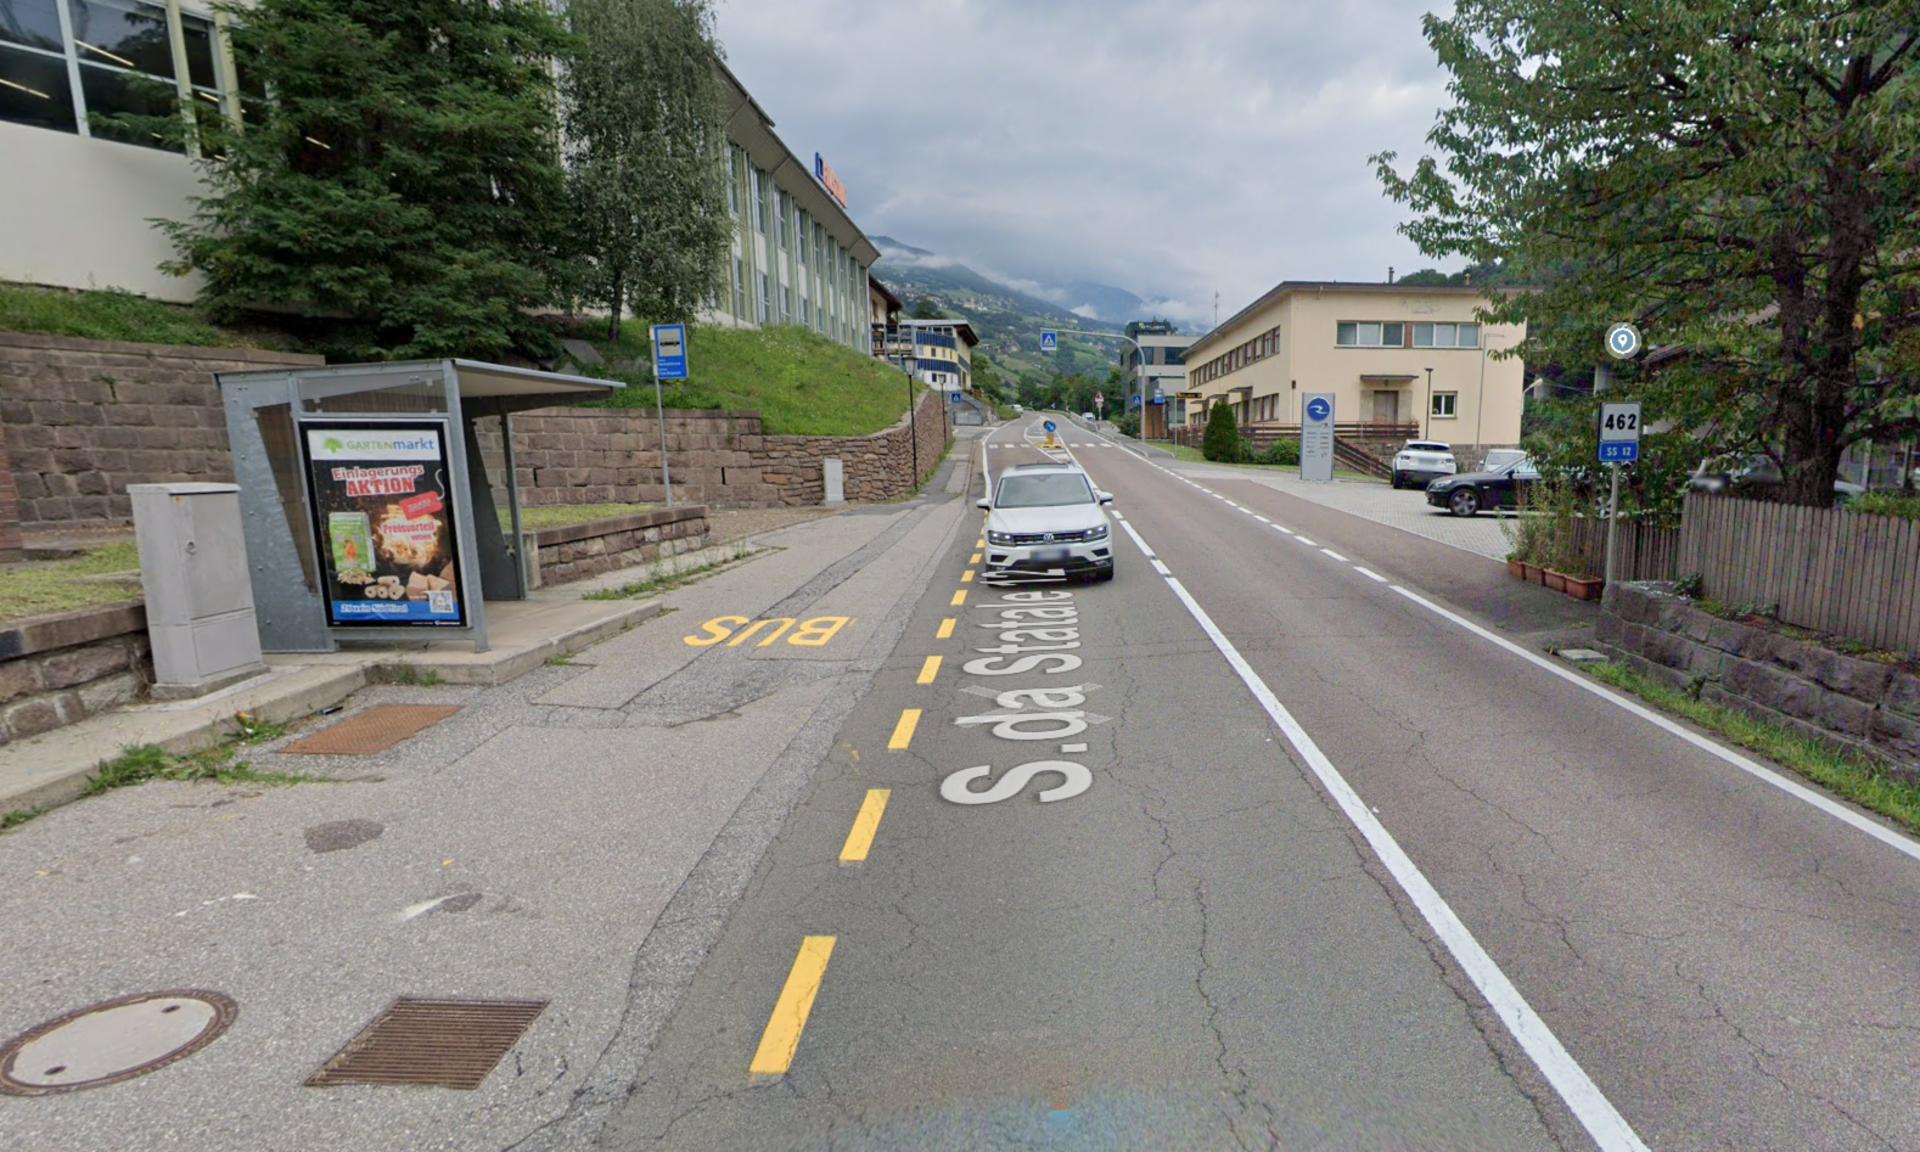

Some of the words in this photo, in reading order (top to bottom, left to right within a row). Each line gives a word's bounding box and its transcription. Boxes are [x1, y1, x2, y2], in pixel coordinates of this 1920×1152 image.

[1605, 413, 1637, 430] 462
[346, 438, 434, 450] GARTENmarkt
[1607, 446, 1618, 457] SS
[1622, 446, 1632, 456] 12
[333, 465, 424, 479] Einlagerungs
[348, 476, 414, 496] AKTION
[683, 616, 849, 648] BUS
